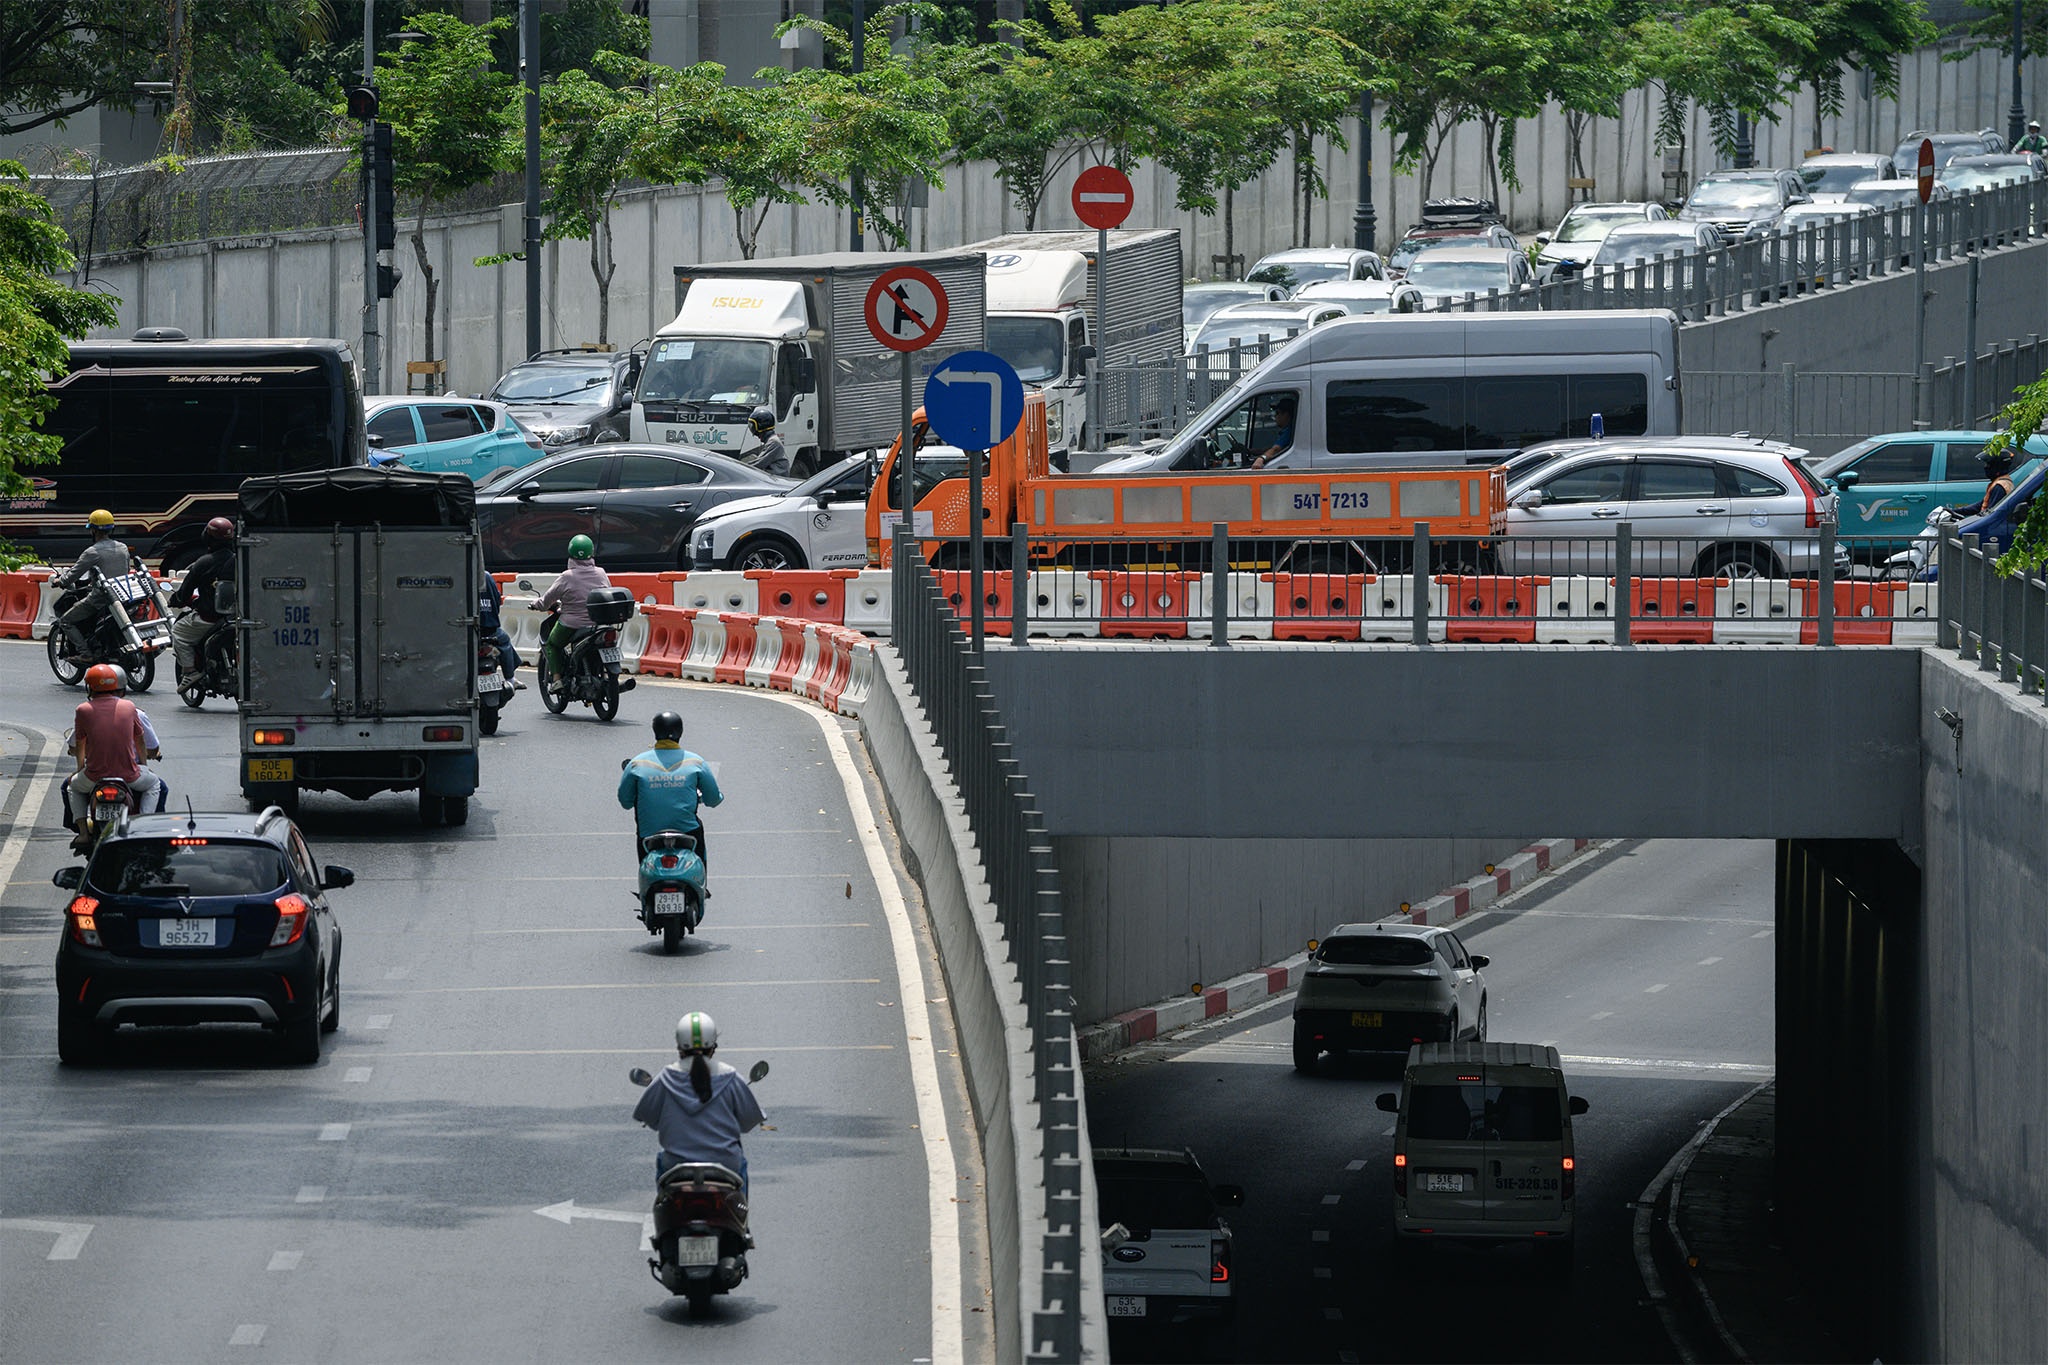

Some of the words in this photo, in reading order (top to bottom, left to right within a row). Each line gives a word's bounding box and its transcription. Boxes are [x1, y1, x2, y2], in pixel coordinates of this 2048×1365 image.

[711, 297, 764, 309] ISUZU
[675, 413, 715, 423] ISUZU
[665, 429, 689, 444] BA
[822, 553, 867, 562] PERFORM
[284, 606, 311, 625] 50E
[273, 628, 320, 647] 160.21
[261, 760, 281, 770] 50E
[255, 770, 288, 781] 160.21
[175, 919, 200, 931] 51H
[165, 931, 209, 944] 965.27
[1118, 1297, 1136, 1306] 63C
[1112, 1306, 1142, 1315] 199.34
